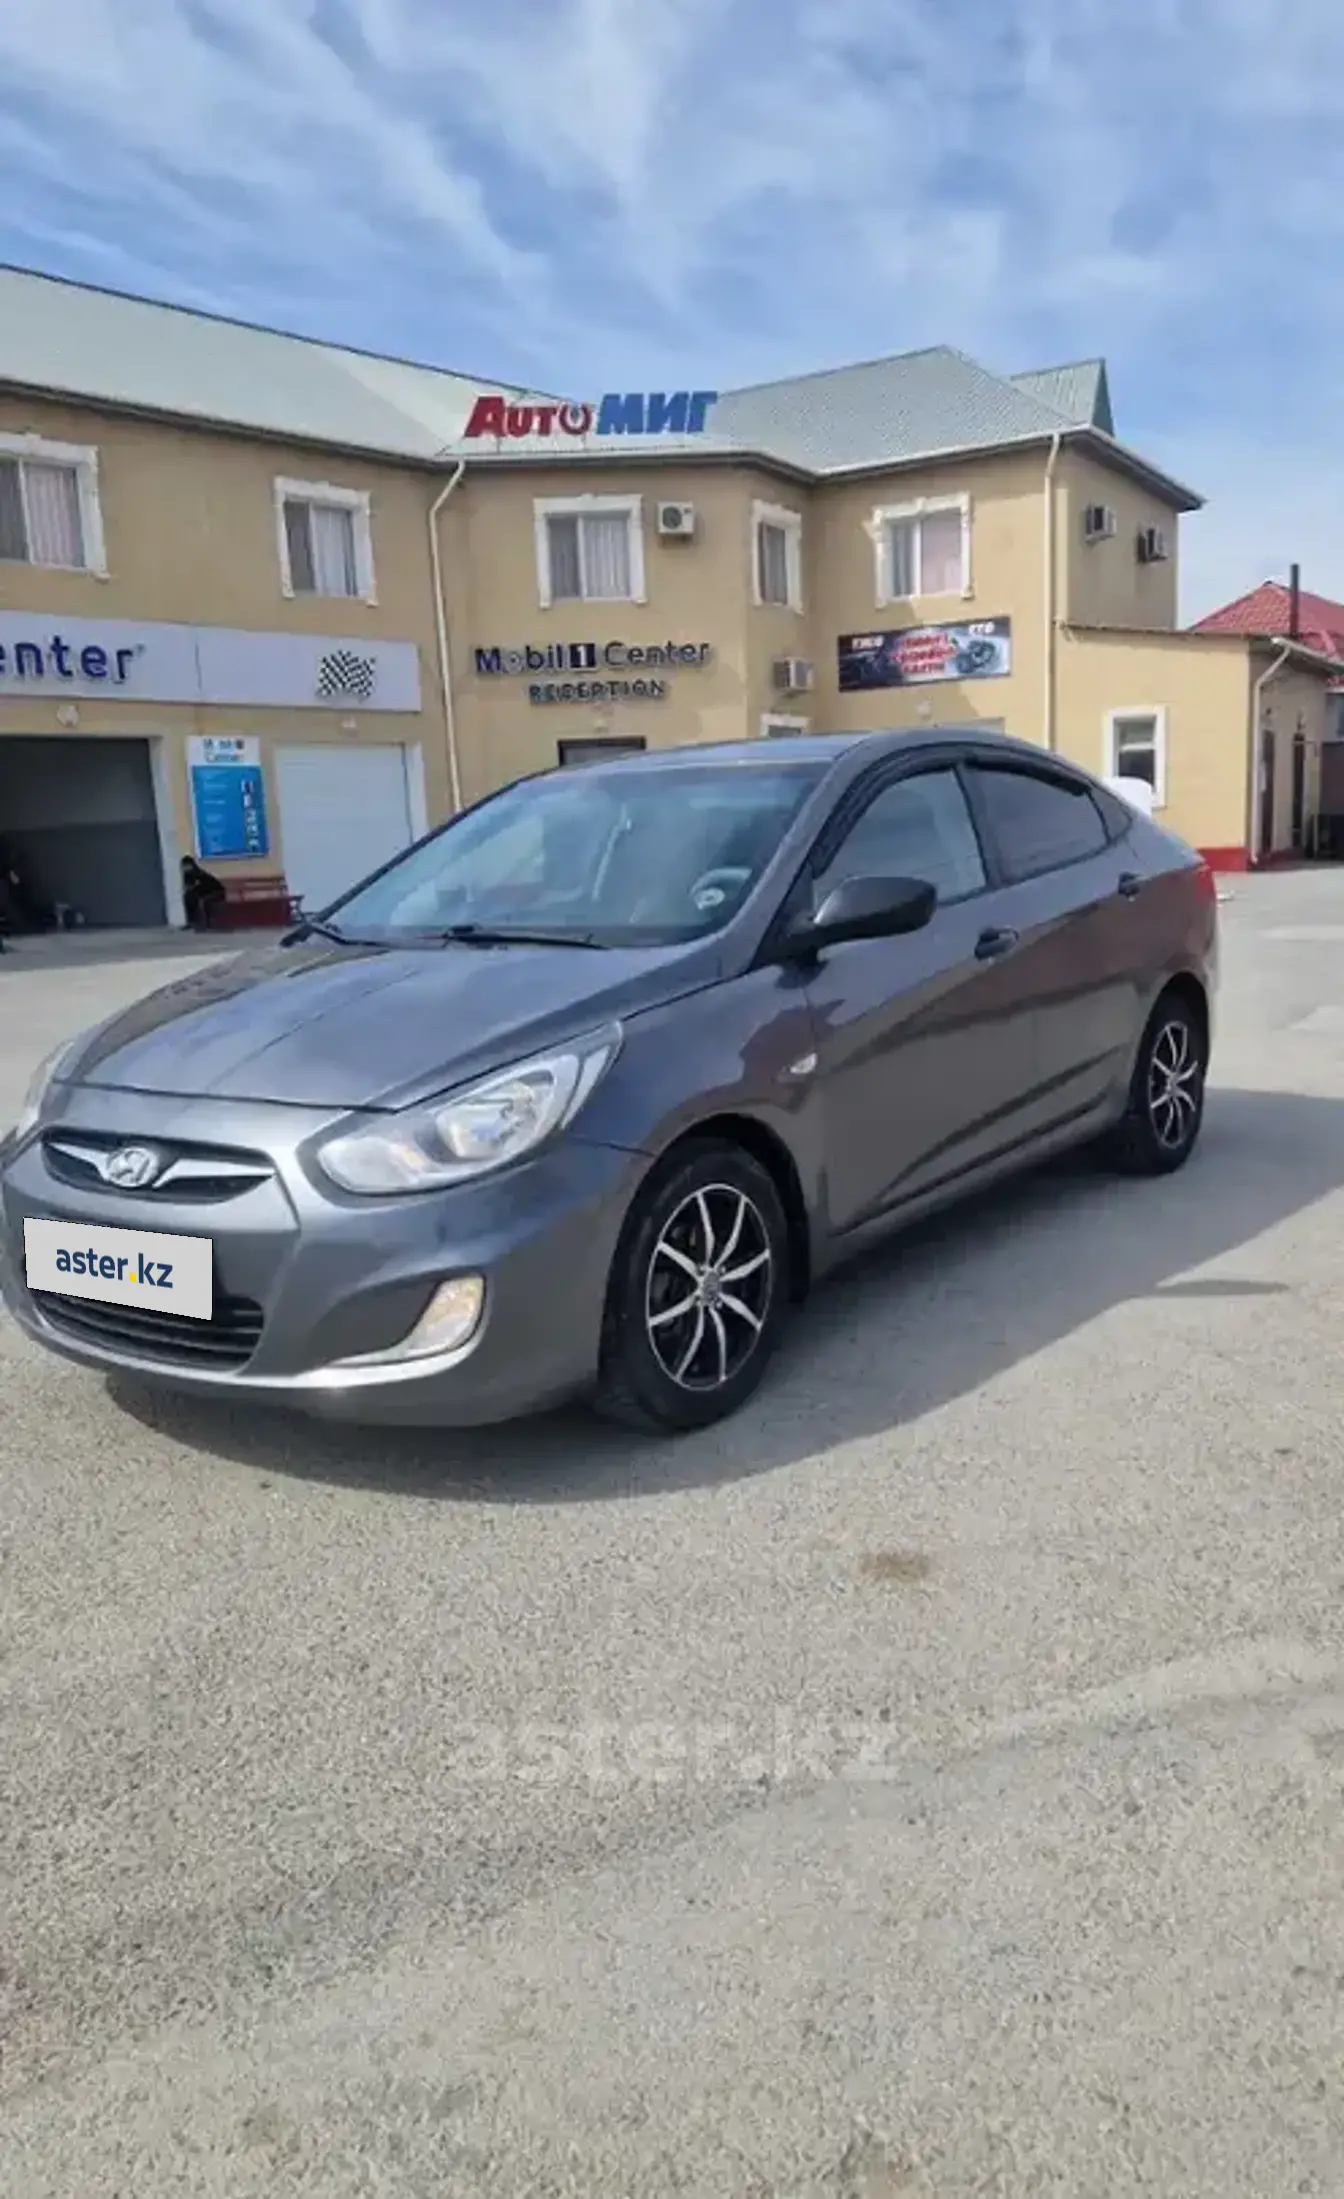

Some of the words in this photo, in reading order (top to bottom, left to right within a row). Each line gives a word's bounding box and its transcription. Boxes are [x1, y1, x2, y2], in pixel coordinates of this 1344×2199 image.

[596, 391, 718, 434] МИГ
[0, 635, 134, 681] nter
[604, 640, 710, 669] Center
[529, 679, 666, 703] RECEPTION
